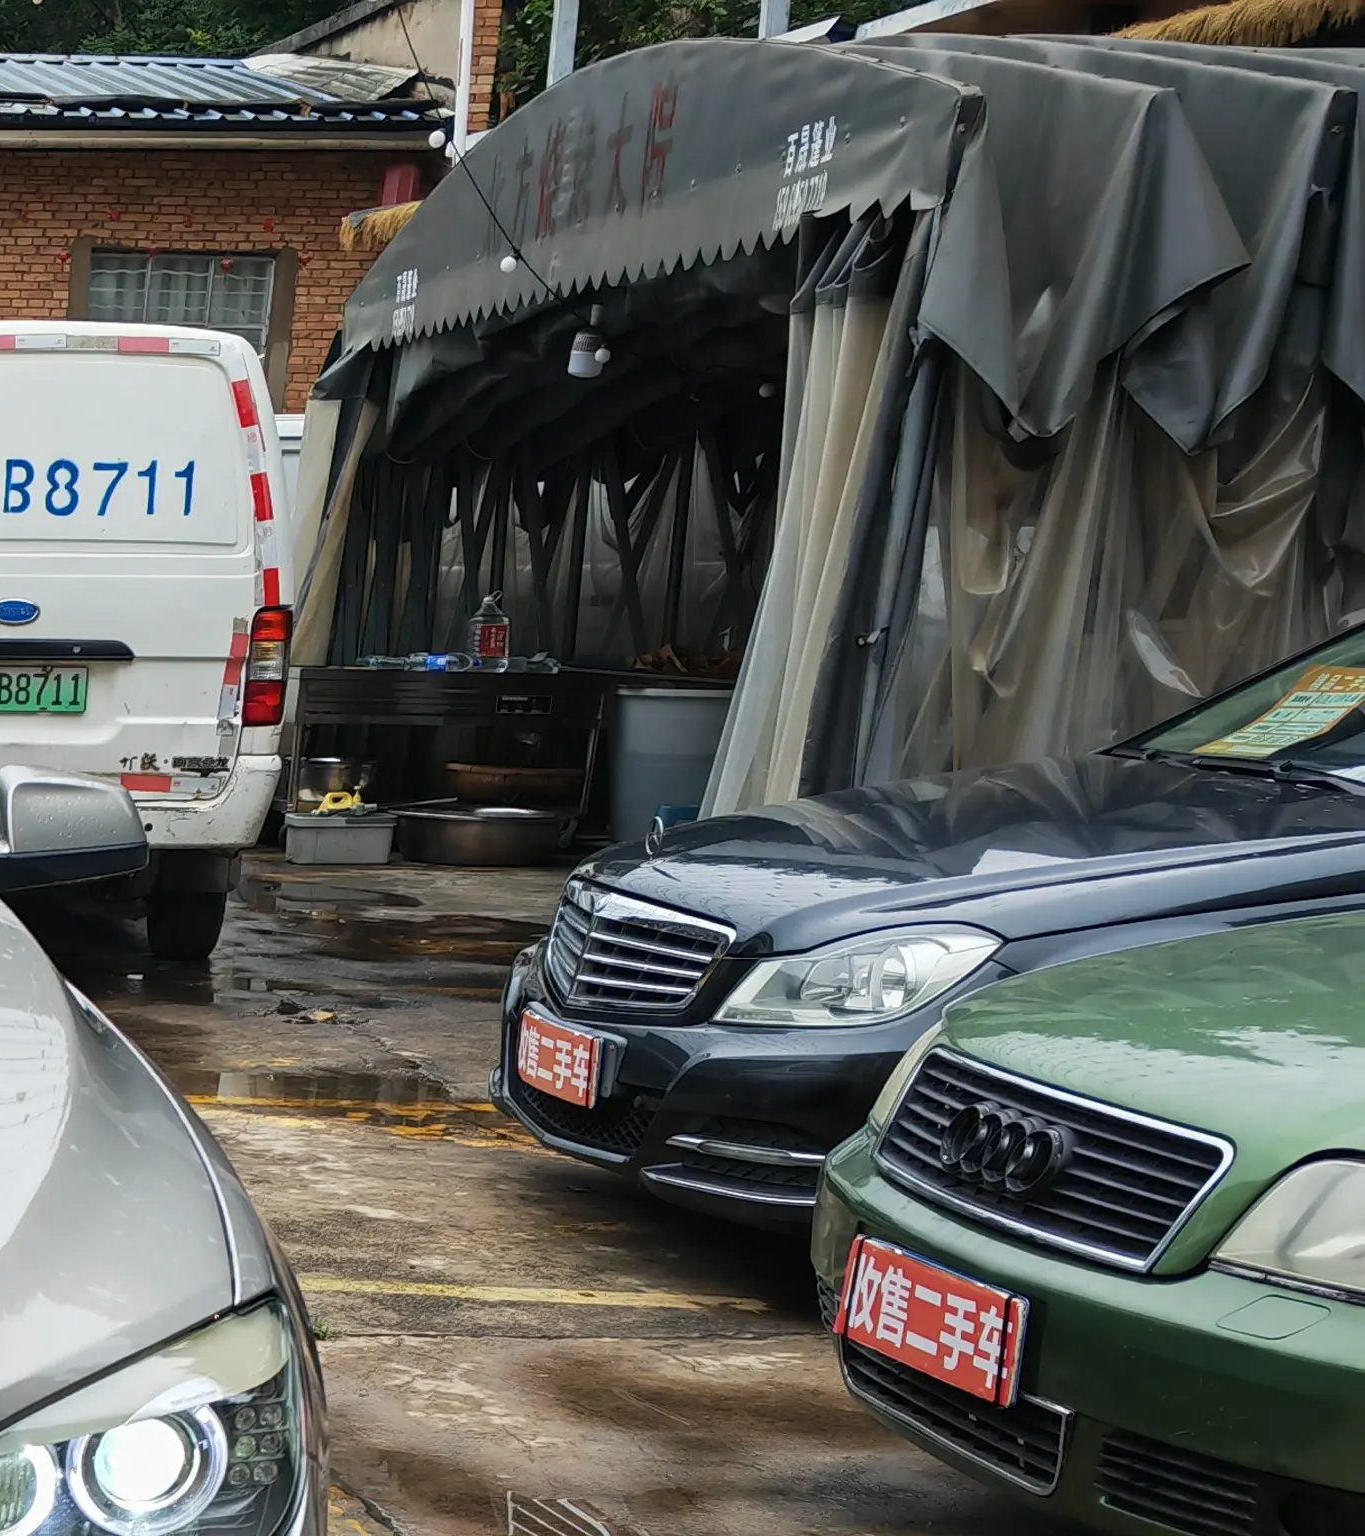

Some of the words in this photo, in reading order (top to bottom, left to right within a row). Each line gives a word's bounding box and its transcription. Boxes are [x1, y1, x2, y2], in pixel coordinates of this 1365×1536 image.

[517, 1019, 590, 1098] 收售二手车
[844, 1252, 1013, 1389] 收售二手车
